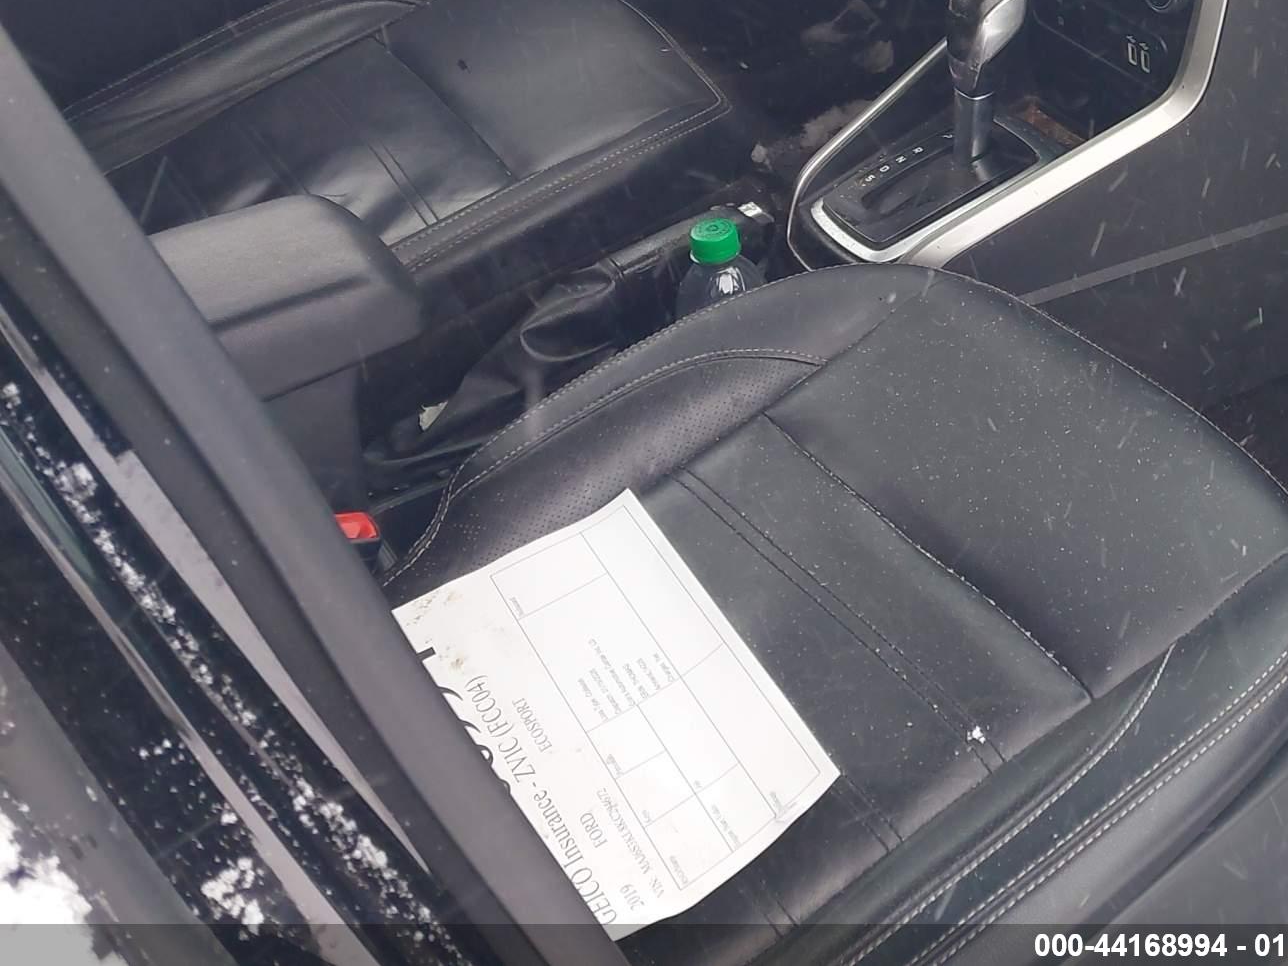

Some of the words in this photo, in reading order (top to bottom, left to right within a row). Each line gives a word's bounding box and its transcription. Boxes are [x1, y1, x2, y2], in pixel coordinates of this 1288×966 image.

[865, 174, 876, 182] S
[879, 165, 890, 173] D
[465, 674, 514, 739] (FCC04)
[512, 697, 552, 754] ECOSPORT
[499, 736, 536, 784] ZVIC
[533, 789, 585, 870] Insurance
[580, 812, 608, 849] FORD
[572, 867, 617, 923] GEICO
[619, 883, 645, 911] 2019
